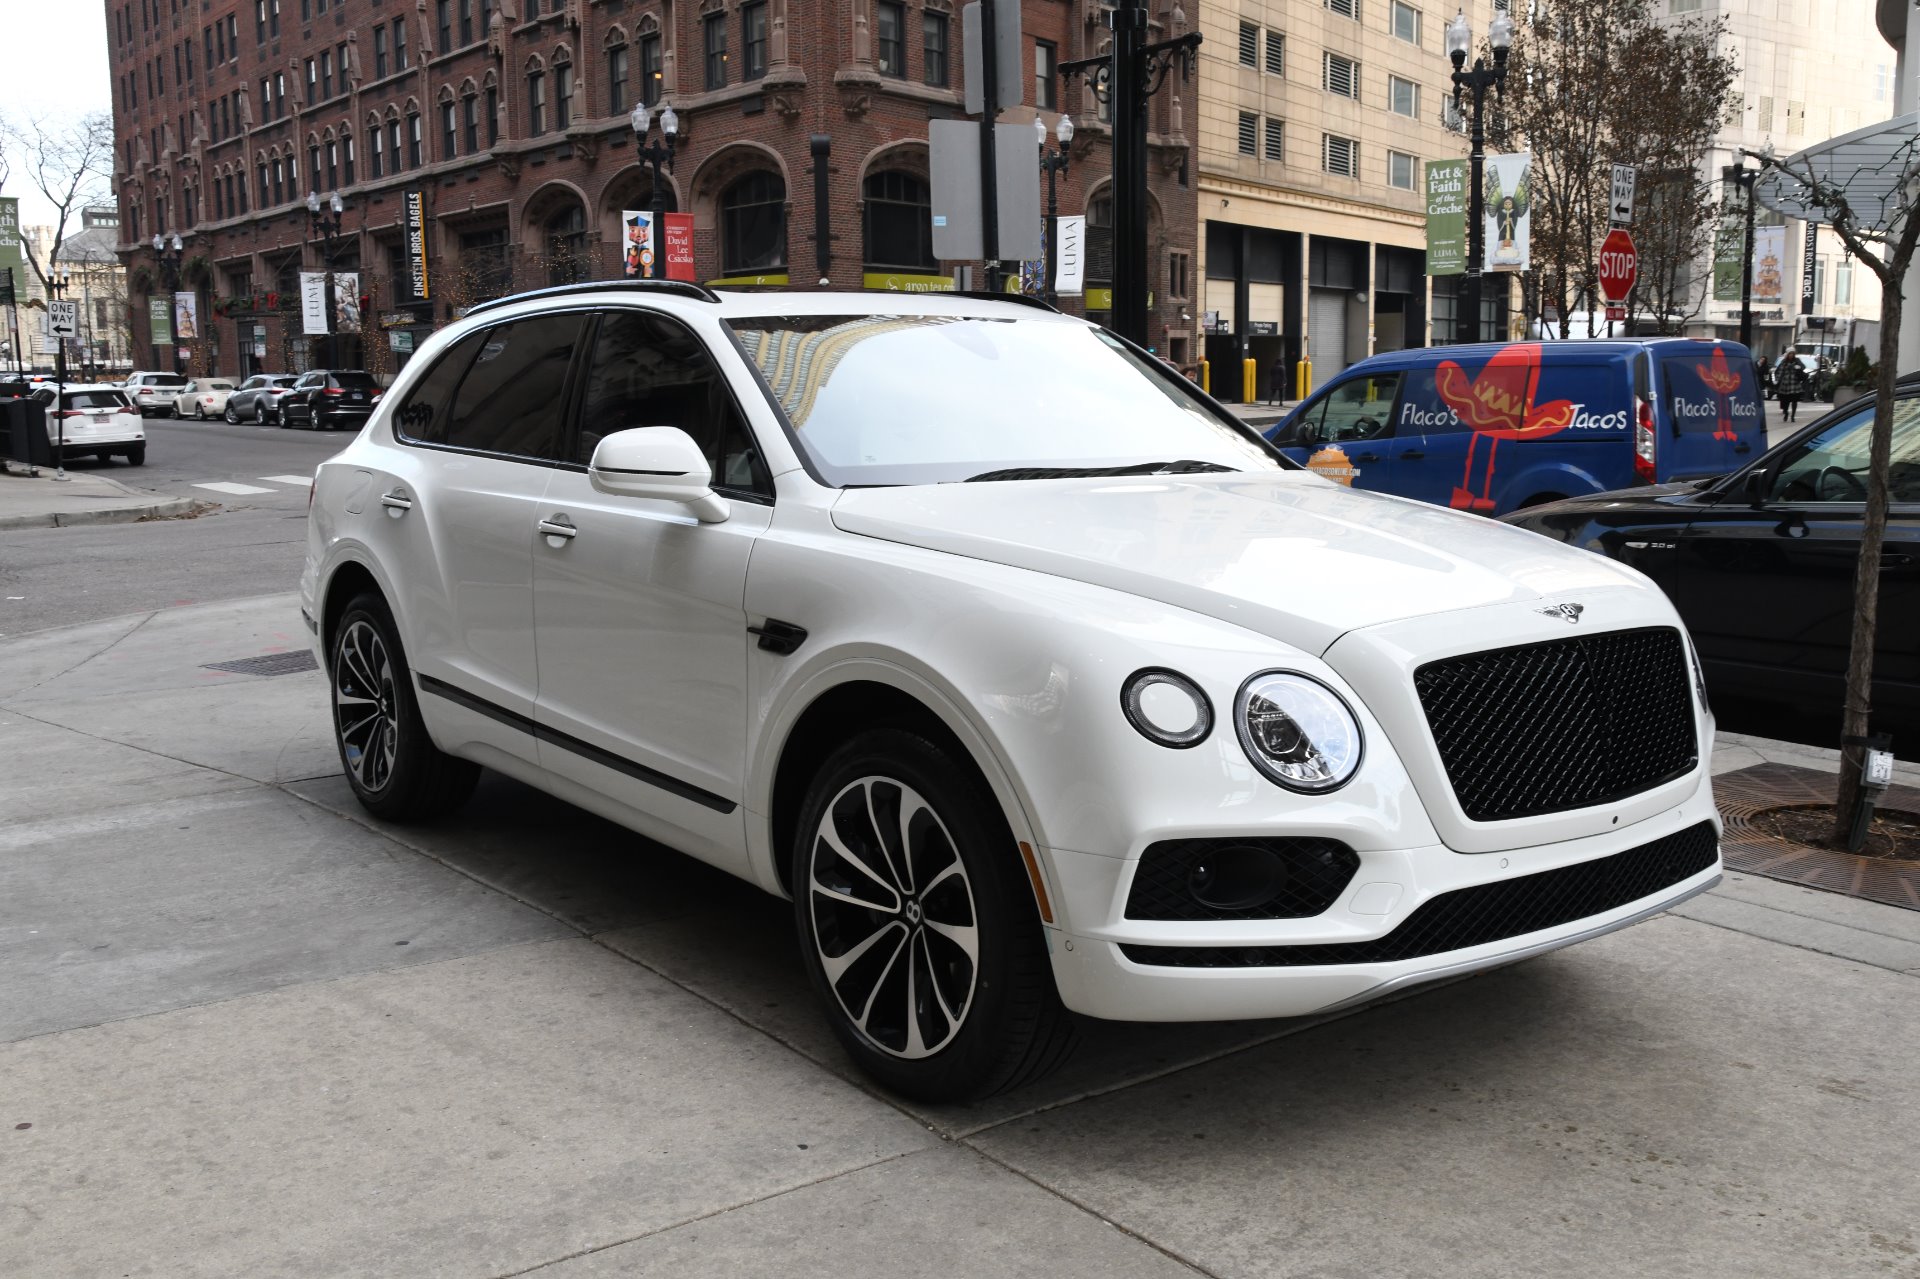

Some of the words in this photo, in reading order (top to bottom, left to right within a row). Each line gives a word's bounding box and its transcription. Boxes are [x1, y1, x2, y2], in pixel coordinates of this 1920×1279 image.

[1429, 167, 1451, 180] Art
[1452, 166, 1463, 178] &
[1615, 169, 1633, 185] ONE
[1430, 179, 1462, 194] Faith
[1614, 185, 1633, 200] WAY
[1435, 195, 1444, 205] of
[1444, 194, 1456, 202] the
[408, 193, 422, 228] BAGELS
[1428, 203, 1463, 215] Creche
[0, 214, 15, 227] th
[667, 235, 688, 245] David
[1804, 222, 1815, 273] ORDSTROM
[676, 245, 689, 254] Lee
[1063, 221, 1077, 277] LUMA
[1433, 249, 1458, 257] LUMA
[1601, 251, 1635, 279] STOP
[412, 256, 425, 297] EINSTEIN
[1802, 274, 1814, 298] rack
[51, 303, 73, 313] ONE
[50, 314, 74, 324] WAY
[1674, 396, 1717, 417] Flaco's
[1728, 396, 1756, 416] Tacos
[1401, 402, 1459, 426] Flaco's
[1568, 404, 1627, 430] Tacos
